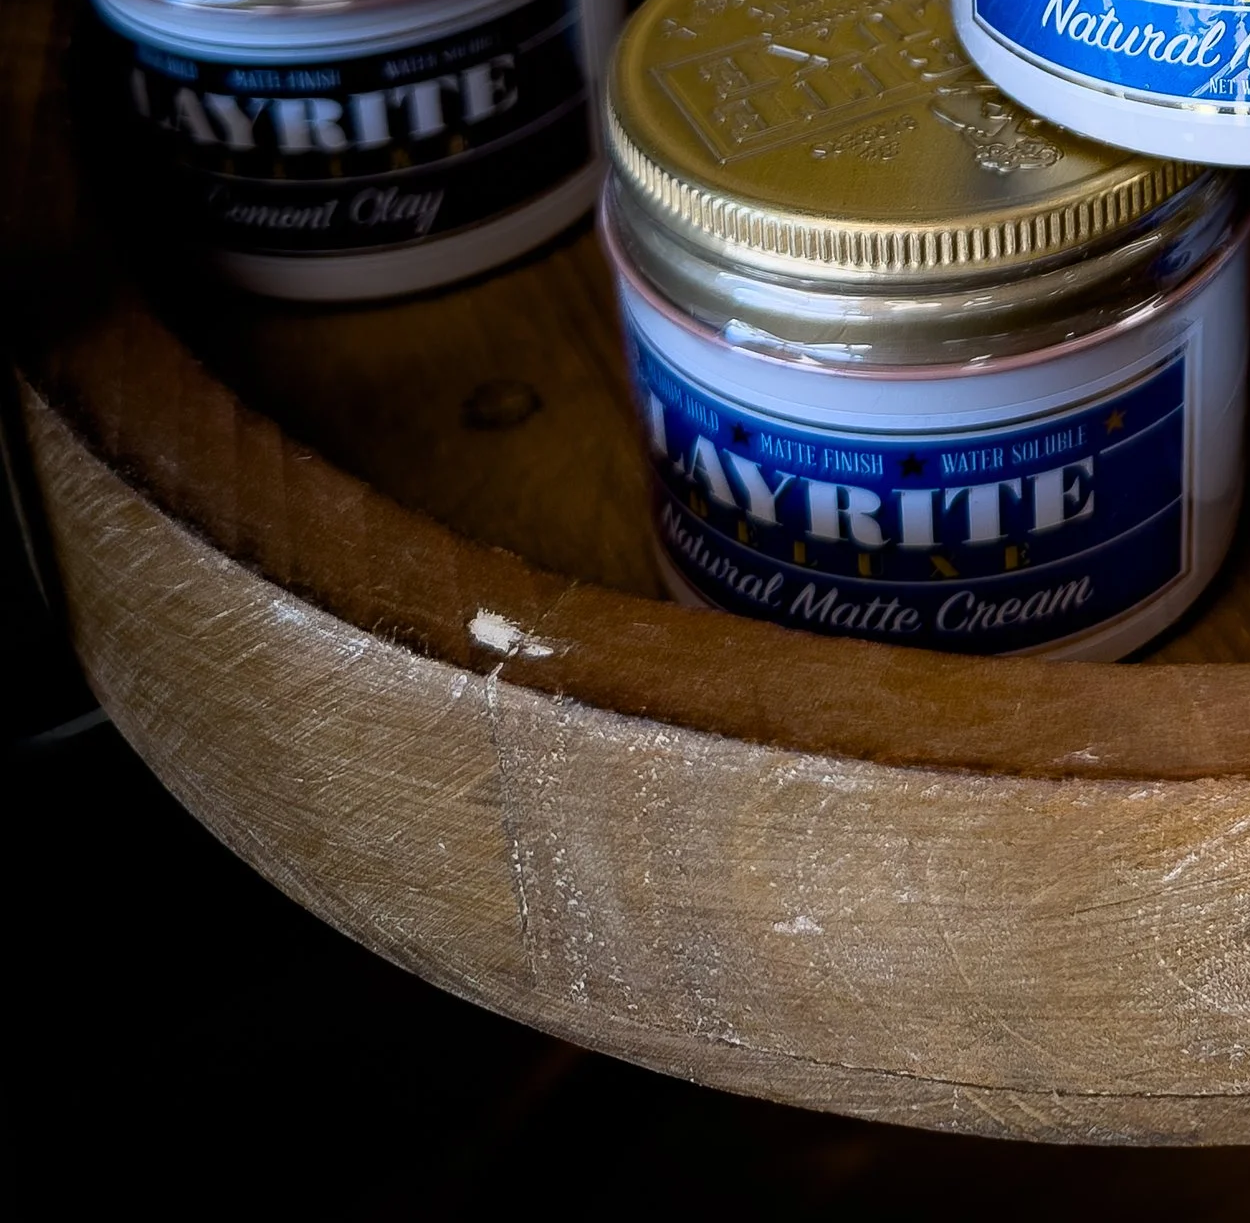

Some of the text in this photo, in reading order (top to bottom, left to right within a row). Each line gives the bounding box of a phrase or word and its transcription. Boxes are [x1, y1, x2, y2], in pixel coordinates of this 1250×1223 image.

[1209, 78, 1235, 95] NET
[650, 390, 1095, 549] LAYRITE
[760, 432, 817, 467] MATTE
[823, 449, 884, 476] FINISH
[941, 451, 1004, 474] WATER
[1010, 424, 1088, 466] SOLUBLE
[662, 501, 1094, 633] Natural Matte Cream
